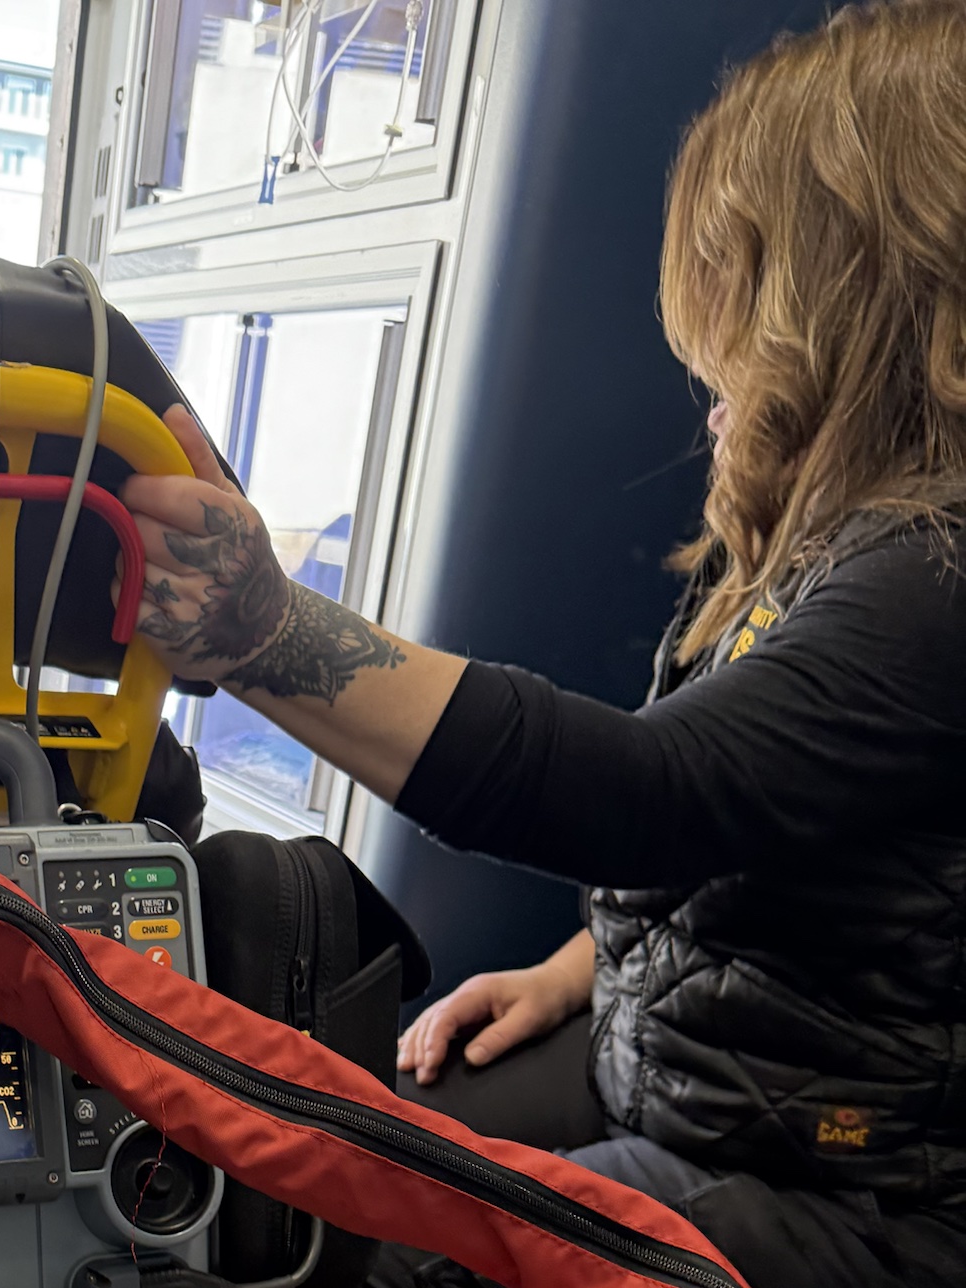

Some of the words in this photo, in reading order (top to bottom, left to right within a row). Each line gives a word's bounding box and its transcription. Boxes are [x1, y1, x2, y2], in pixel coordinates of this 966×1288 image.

[109, 873, 116, 888] 1
[146, 873, 158, 883] ON
[142, 899, 165, 907] ENERGY
[77, 903, 94, 915] CPR
[111, 902, 121, 916] 2
[143, 905, 165, 914] SELECT
[113, 925, 122, 939] 3
[141, 925, 169, 934] CHARGE
[1, 1055, 12, 1065] 50
